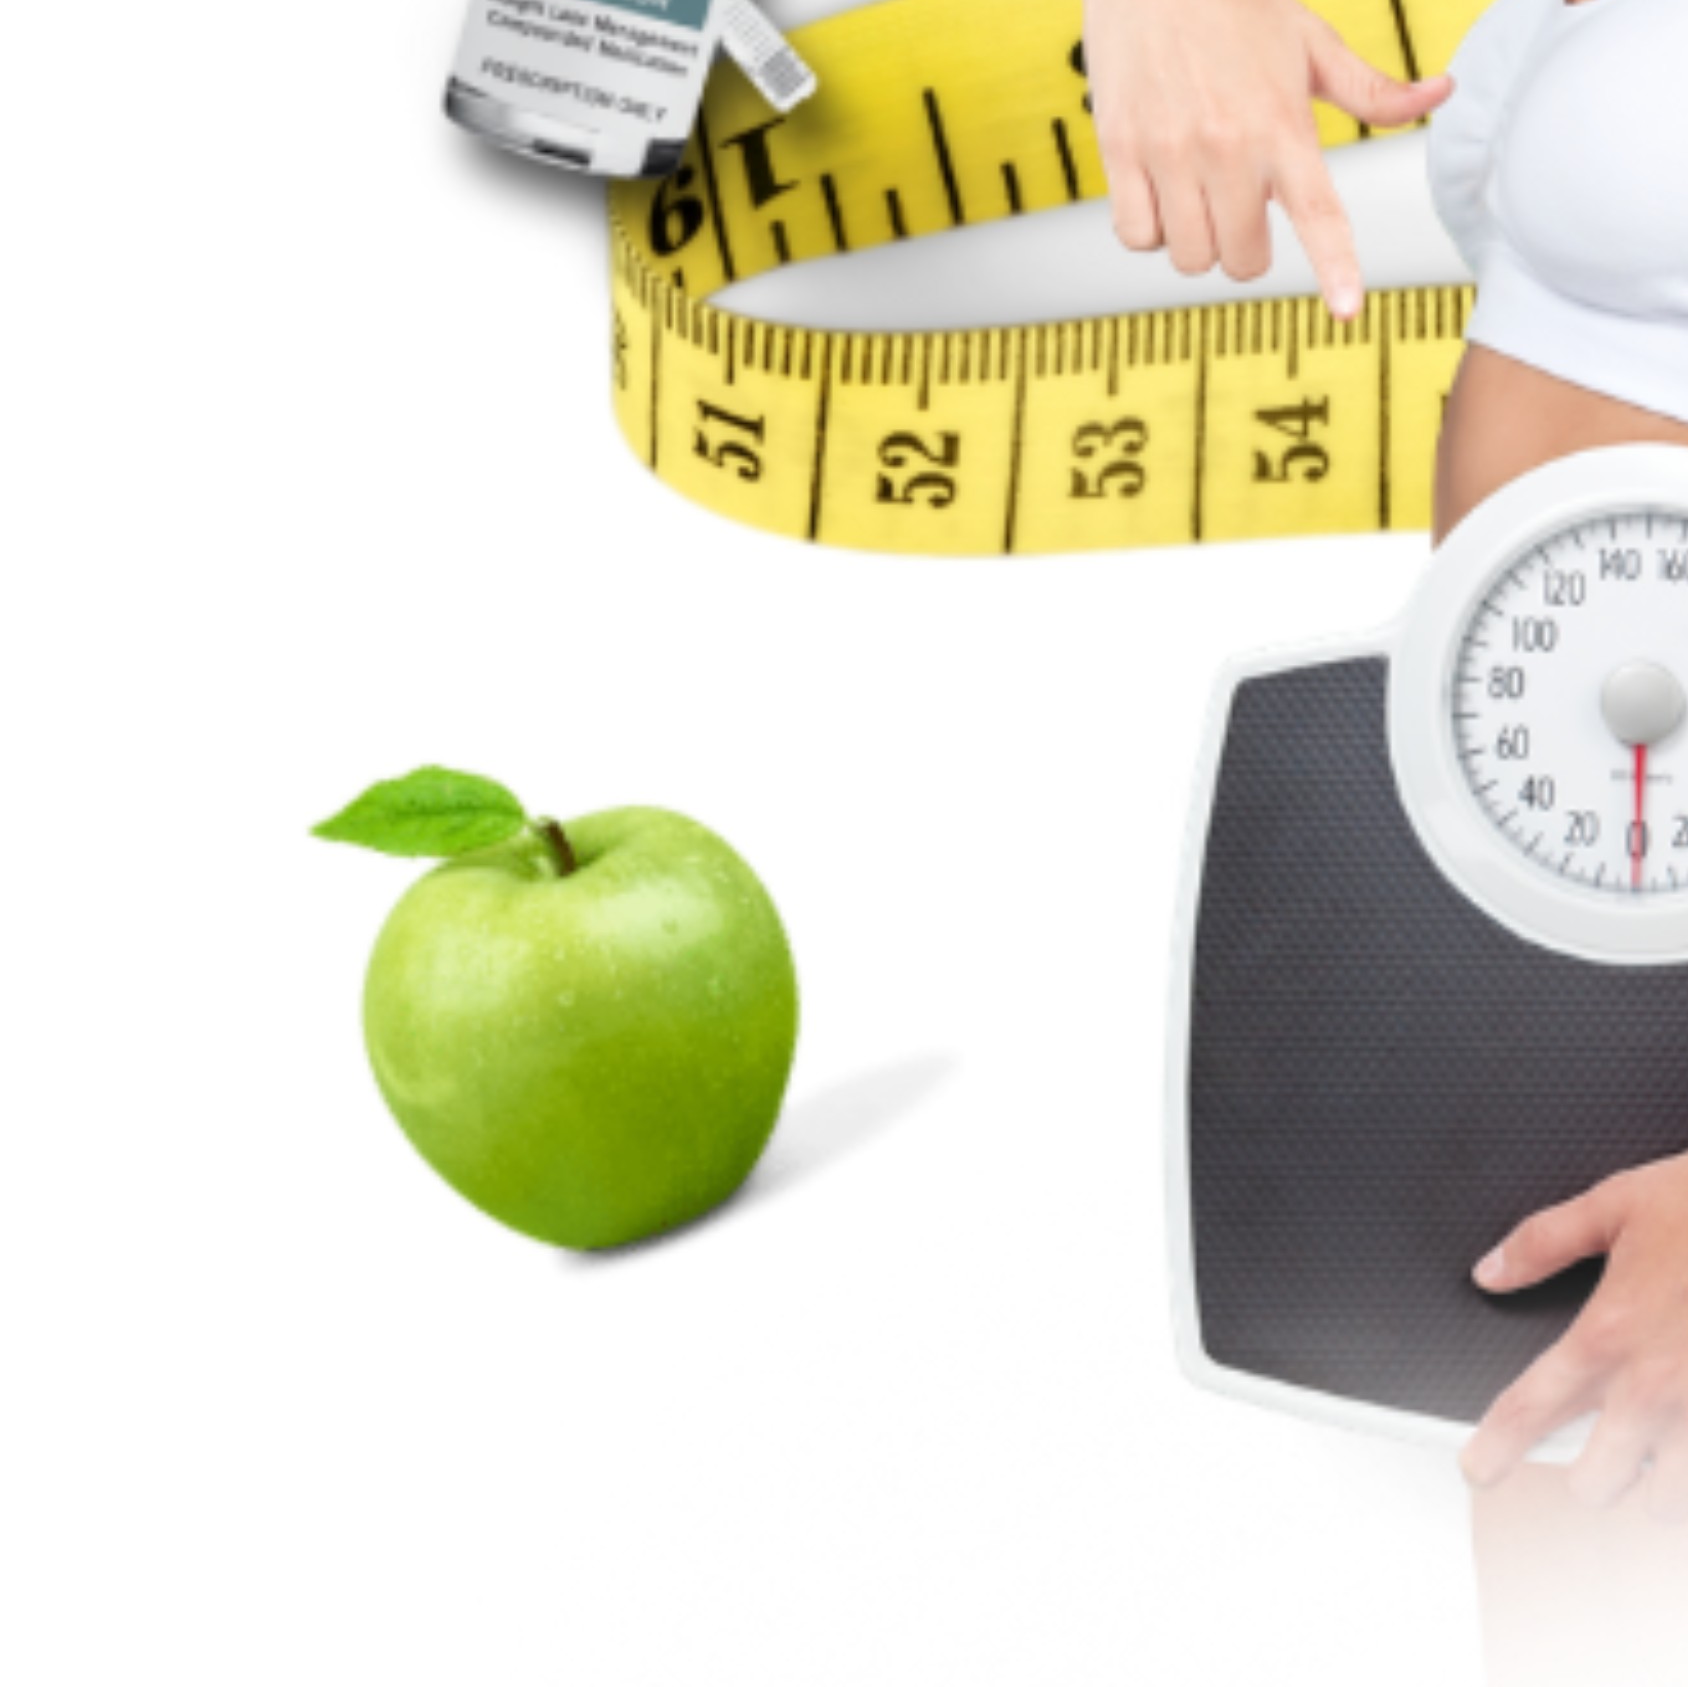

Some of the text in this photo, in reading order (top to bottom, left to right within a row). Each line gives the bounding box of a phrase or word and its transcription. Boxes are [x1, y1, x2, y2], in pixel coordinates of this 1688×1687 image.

[693, 398, 765, 482] 51
[876, 429, 959, 510] 52
[1068, 415, 1150, 500] 53
[1251, 394, 1329, 485] 54
[1599, 548, 1641, 580] 140
[1544, 570, 1586, 606] 120
[1512, 617, 1559, 652] 100
[1488, 666, 1525, 699] 80
[1497, 725, 1529, 760] 60
[1518, 775, 1556, 810] 40
[1564, 811, 1598, 846] 20
[1626, 821, 1649, 859] 0
